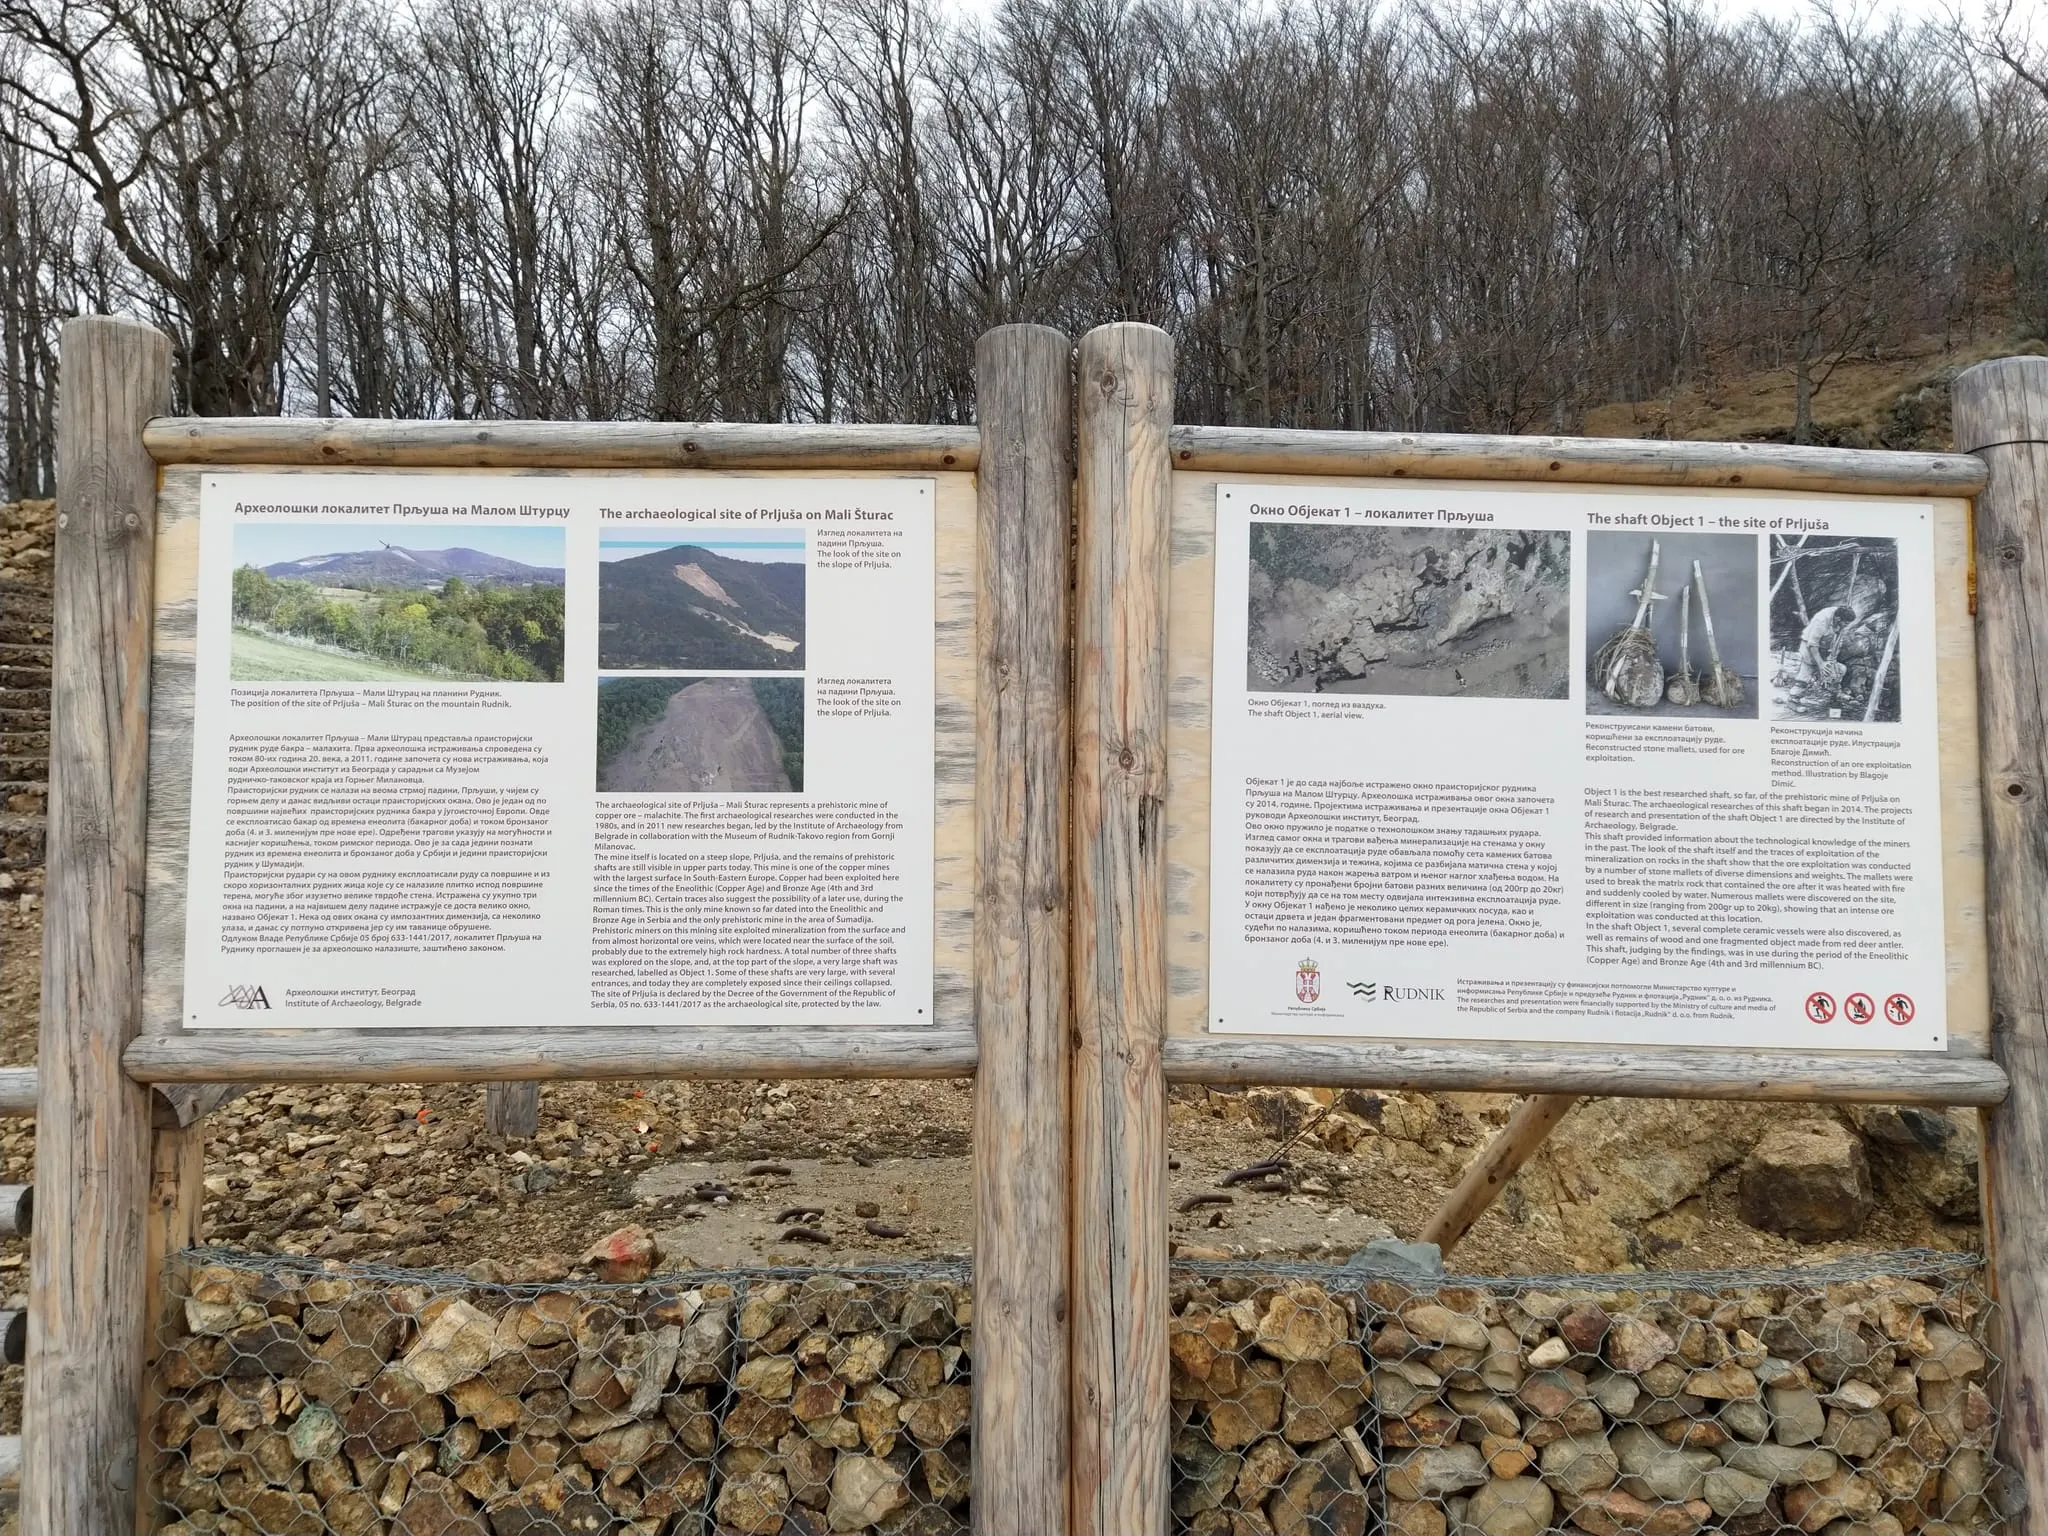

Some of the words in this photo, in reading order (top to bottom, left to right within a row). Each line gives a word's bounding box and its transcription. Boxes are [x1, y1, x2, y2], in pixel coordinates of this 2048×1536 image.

[234, 501, 318, 516] Археолошки
[320, 505, 390, 514] локалитет
[392, 503, 448, 517] Прљуша
[451, 506, 467, 515] на
[470, 504, 516, 515] Малом
[519, 504, 570, 519] Штурцу
[598, 507, 622, 518] The
[624, 507, 716, 522] archaeological
[719, 508, 742, 519] site
[744, 508, 758, 519] of
[760, 508, 802, 522] Prljuša
[805, 511, 822, 520] on
[824, 508, 851, 520] Mali
[854, 507, 894, 520] Šturac
[1249, 503, 1285, 516] Окно
[1287, 504, 1341, 520] Објекат
[1363, 509, 1434, 520] локалитет
[1437, 508, 1494, 524] Прљуша
[1586, 511, 1611, 524] The
[1614, 512, 1648, 525] shaft
[1650, 513, 1694, 529] Object
[1717, 515, 1740, 527] the
[1742, 516, 1766, 528] site
[1768, 516, 1783, 528] of
[1785, 517, 1829, 533] Prljuša
[816, 528, 846, 537] Изглед
[816, 540, 847, 548] падини
[816, 549, 832, 557] The
[832, 549, 850, 557] look
[860, 549, 874, 557] the
[875, 550, 890, 558] site
[816, 559, 831, 568] the
[831, 560, 853, 569] slope
[230, 688, 269, 698] Позиција
[318, 688, 354, 698] Прљуша
[362, 688, 386, 696] Мали
[386, 688, 420, 698] Штурац
[229, 698, 246, 707] The
[246, 698, 280, 708] position
[290, 699, 305, 707] the
[306, 699, 321, 707] site
[332, 699, 360, 709] Prljuša
[367, 699, 385, 707] Mali
[386, 698, 412, 708] Šturac
[425, 699, 440, 707] the
[440, 699, 480, 708] mountain
[1247, 708, 1262, 717] The
[1263, 708, 1284, 717] shaft
[1284, 709, 1311, 719] Object
[1320, 710, 1342, 719] aerial
[1584, 742, 1642, 752] Reconstructed
[1697, 745, 1718, 754] used
[1770, 757, 1830, 767] Reconstruction
[1864, 760, 1912, 770] exploitation
[1804, 769, 1848, 778] Illustration
[1858, 770, 1888, 781] Blagoje
[594, 800, 610, 808] The
[610, 800, 667, 810] archaeological
[692, 800, 718, 810] Prljuša
[725, 800, 743, 808] Mali
[743, 799, 768, 808] Šturac
[768, 801, 810, 810] represents
[816, 800, 858, 810] prehistoric
[1586, 955, 1620, 966] (Copper
[1620, 956, 1640, 966] Age)
[1641, 956, 1658, 965] and
[1658, 957, 1689, 966] Bronze
[1689, 958, 1707, 968] Age
[1707, 958, 1725, 968] (4th
[1725, 959, 1742, 968] and
[1743, 959, 1758, 968] 3rd
[1759, 960, 1806, 969] millennium
[284, 988, 339, 997] Археолошки
[380, 987, 416, 997] Београд
[1382, 984, 1445, 1004] RUDNIK
[284, 999, 320, 1007] Institute
[330, 998, 384, 1008] Archaeology,
[384, 998, 422, 1008] Belgrade
